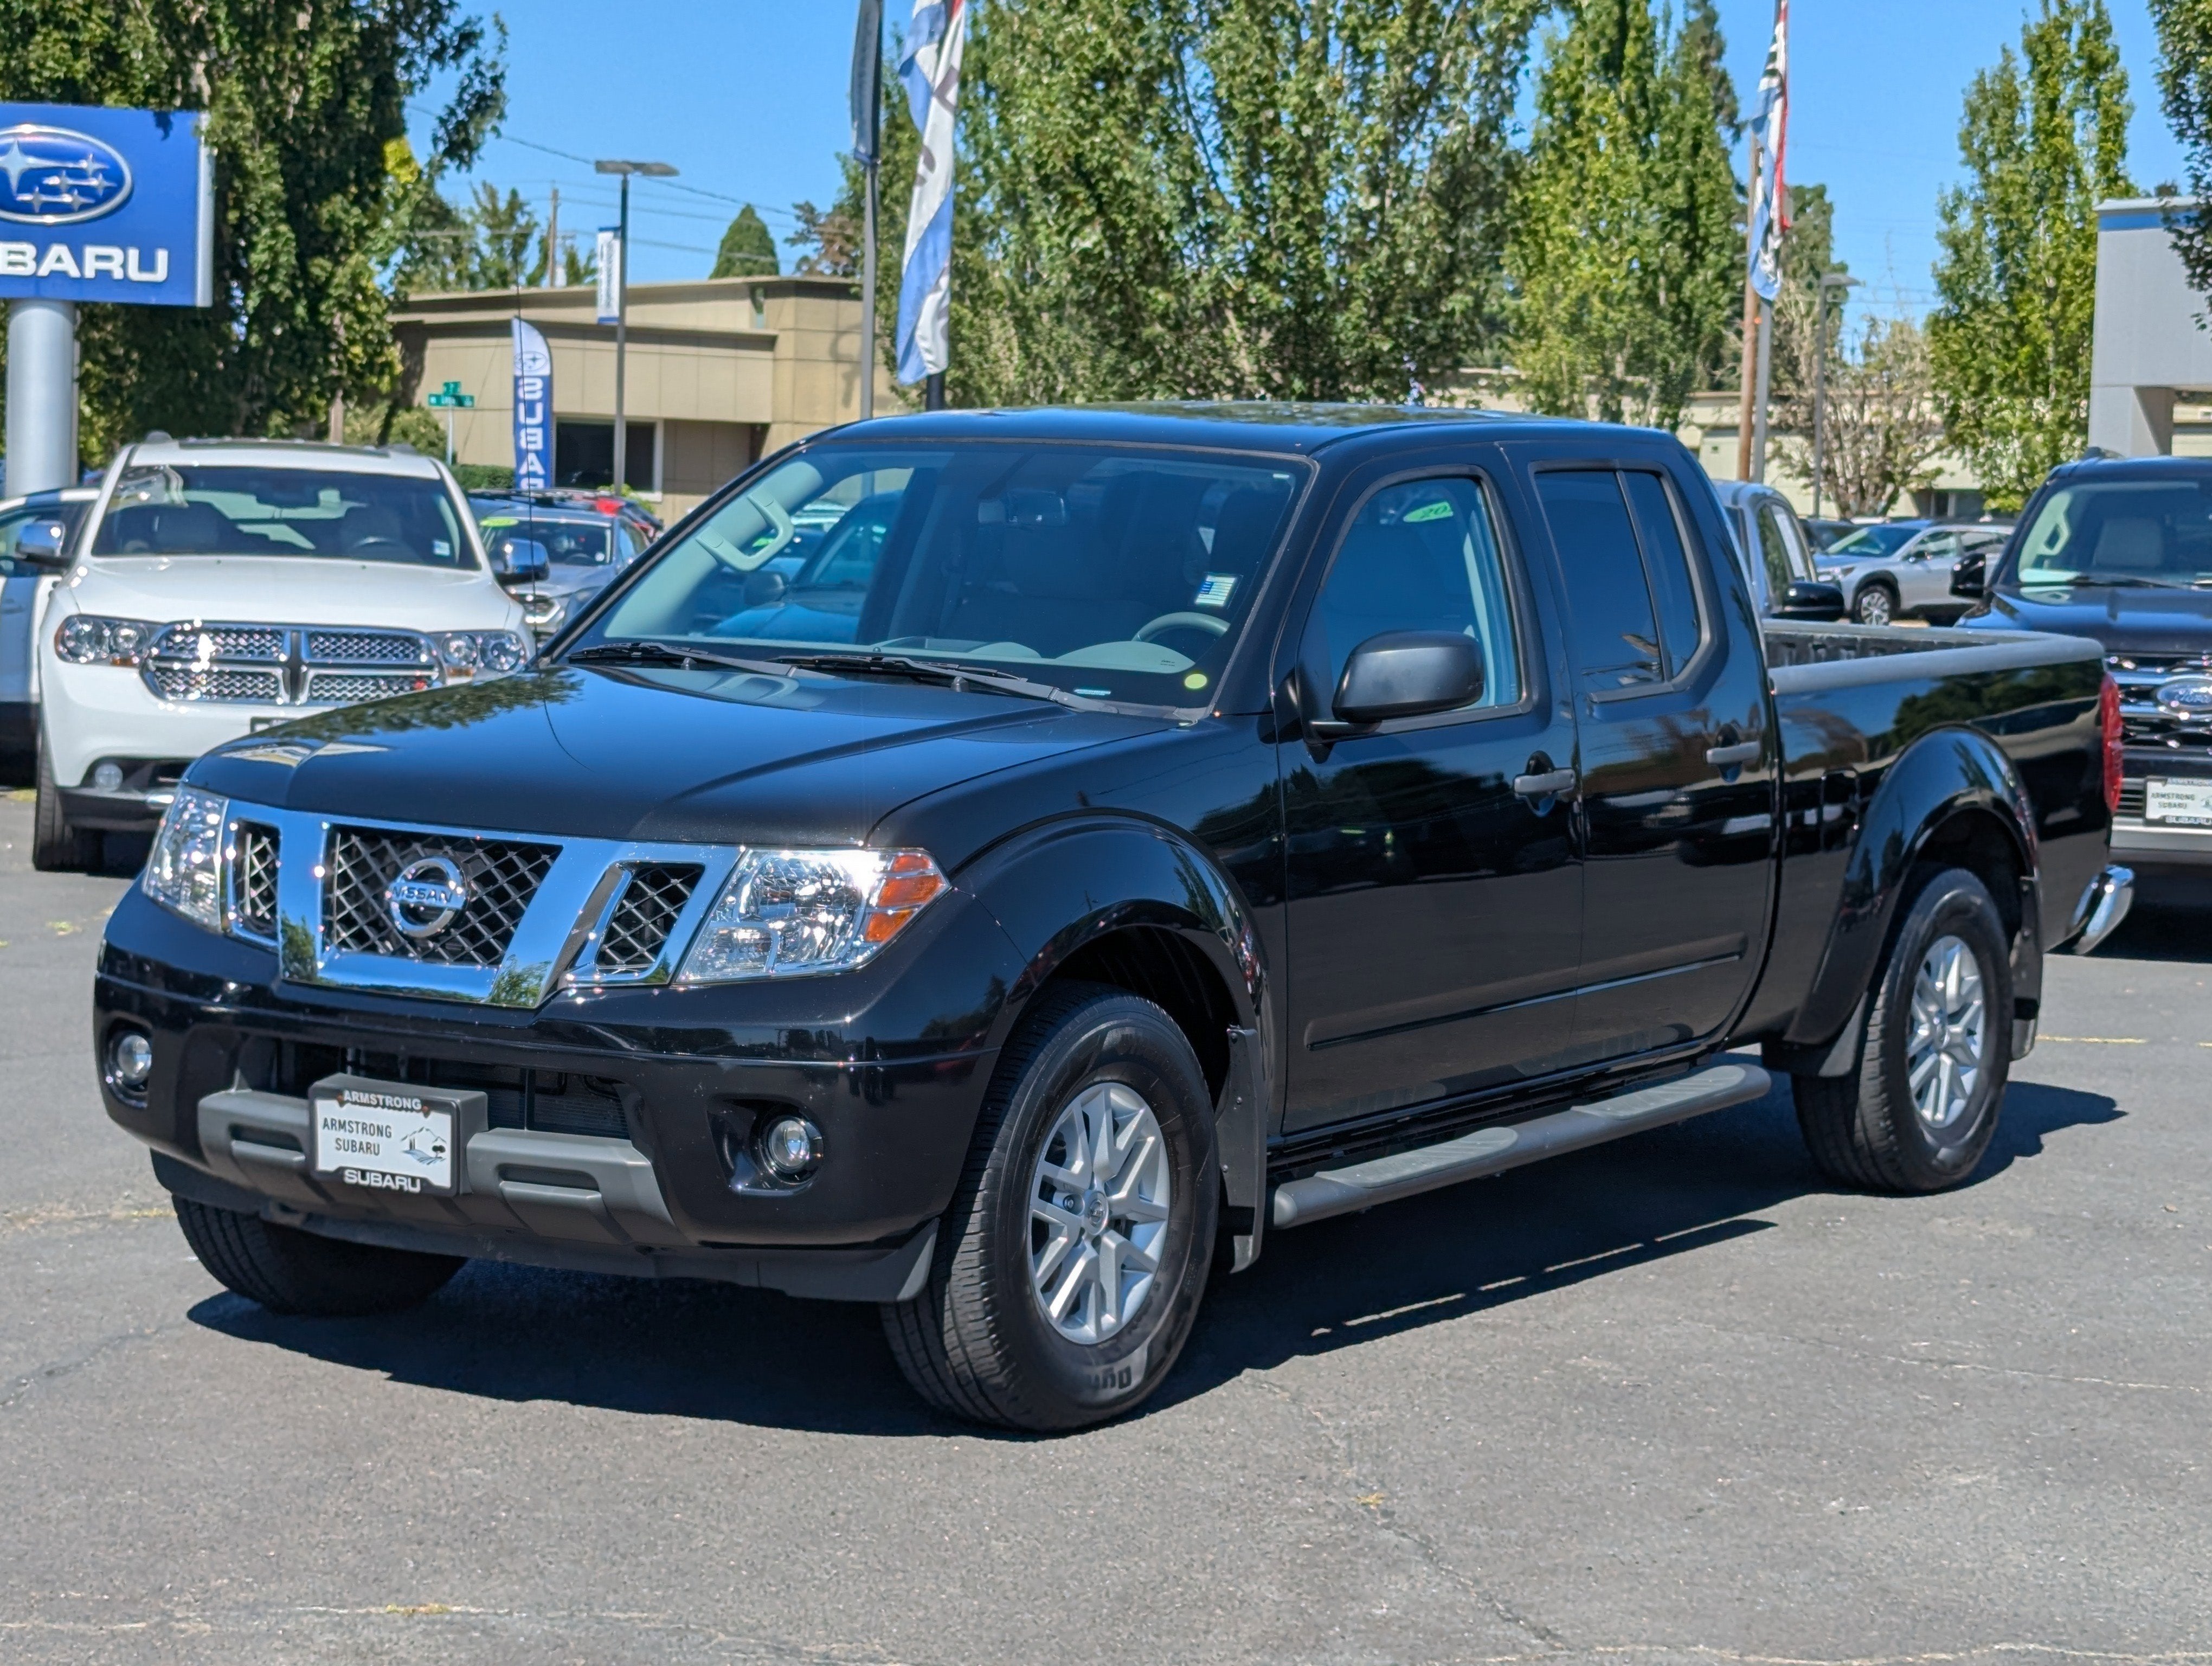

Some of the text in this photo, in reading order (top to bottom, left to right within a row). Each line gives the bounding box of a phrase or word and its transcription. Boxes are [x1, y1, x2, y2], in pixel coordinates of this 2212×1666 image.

[0, 241, 168, 282] BARU
[393, 885, 453, 903] NISSAN
[343, 1090, 422, 1110] ARMSTRONG
[323, 1117, 392, 1138] ARMSTRONG
[335, 1137, 381, 1156] SUBARU
[343, 1169, 421, 1193] SUBARU
